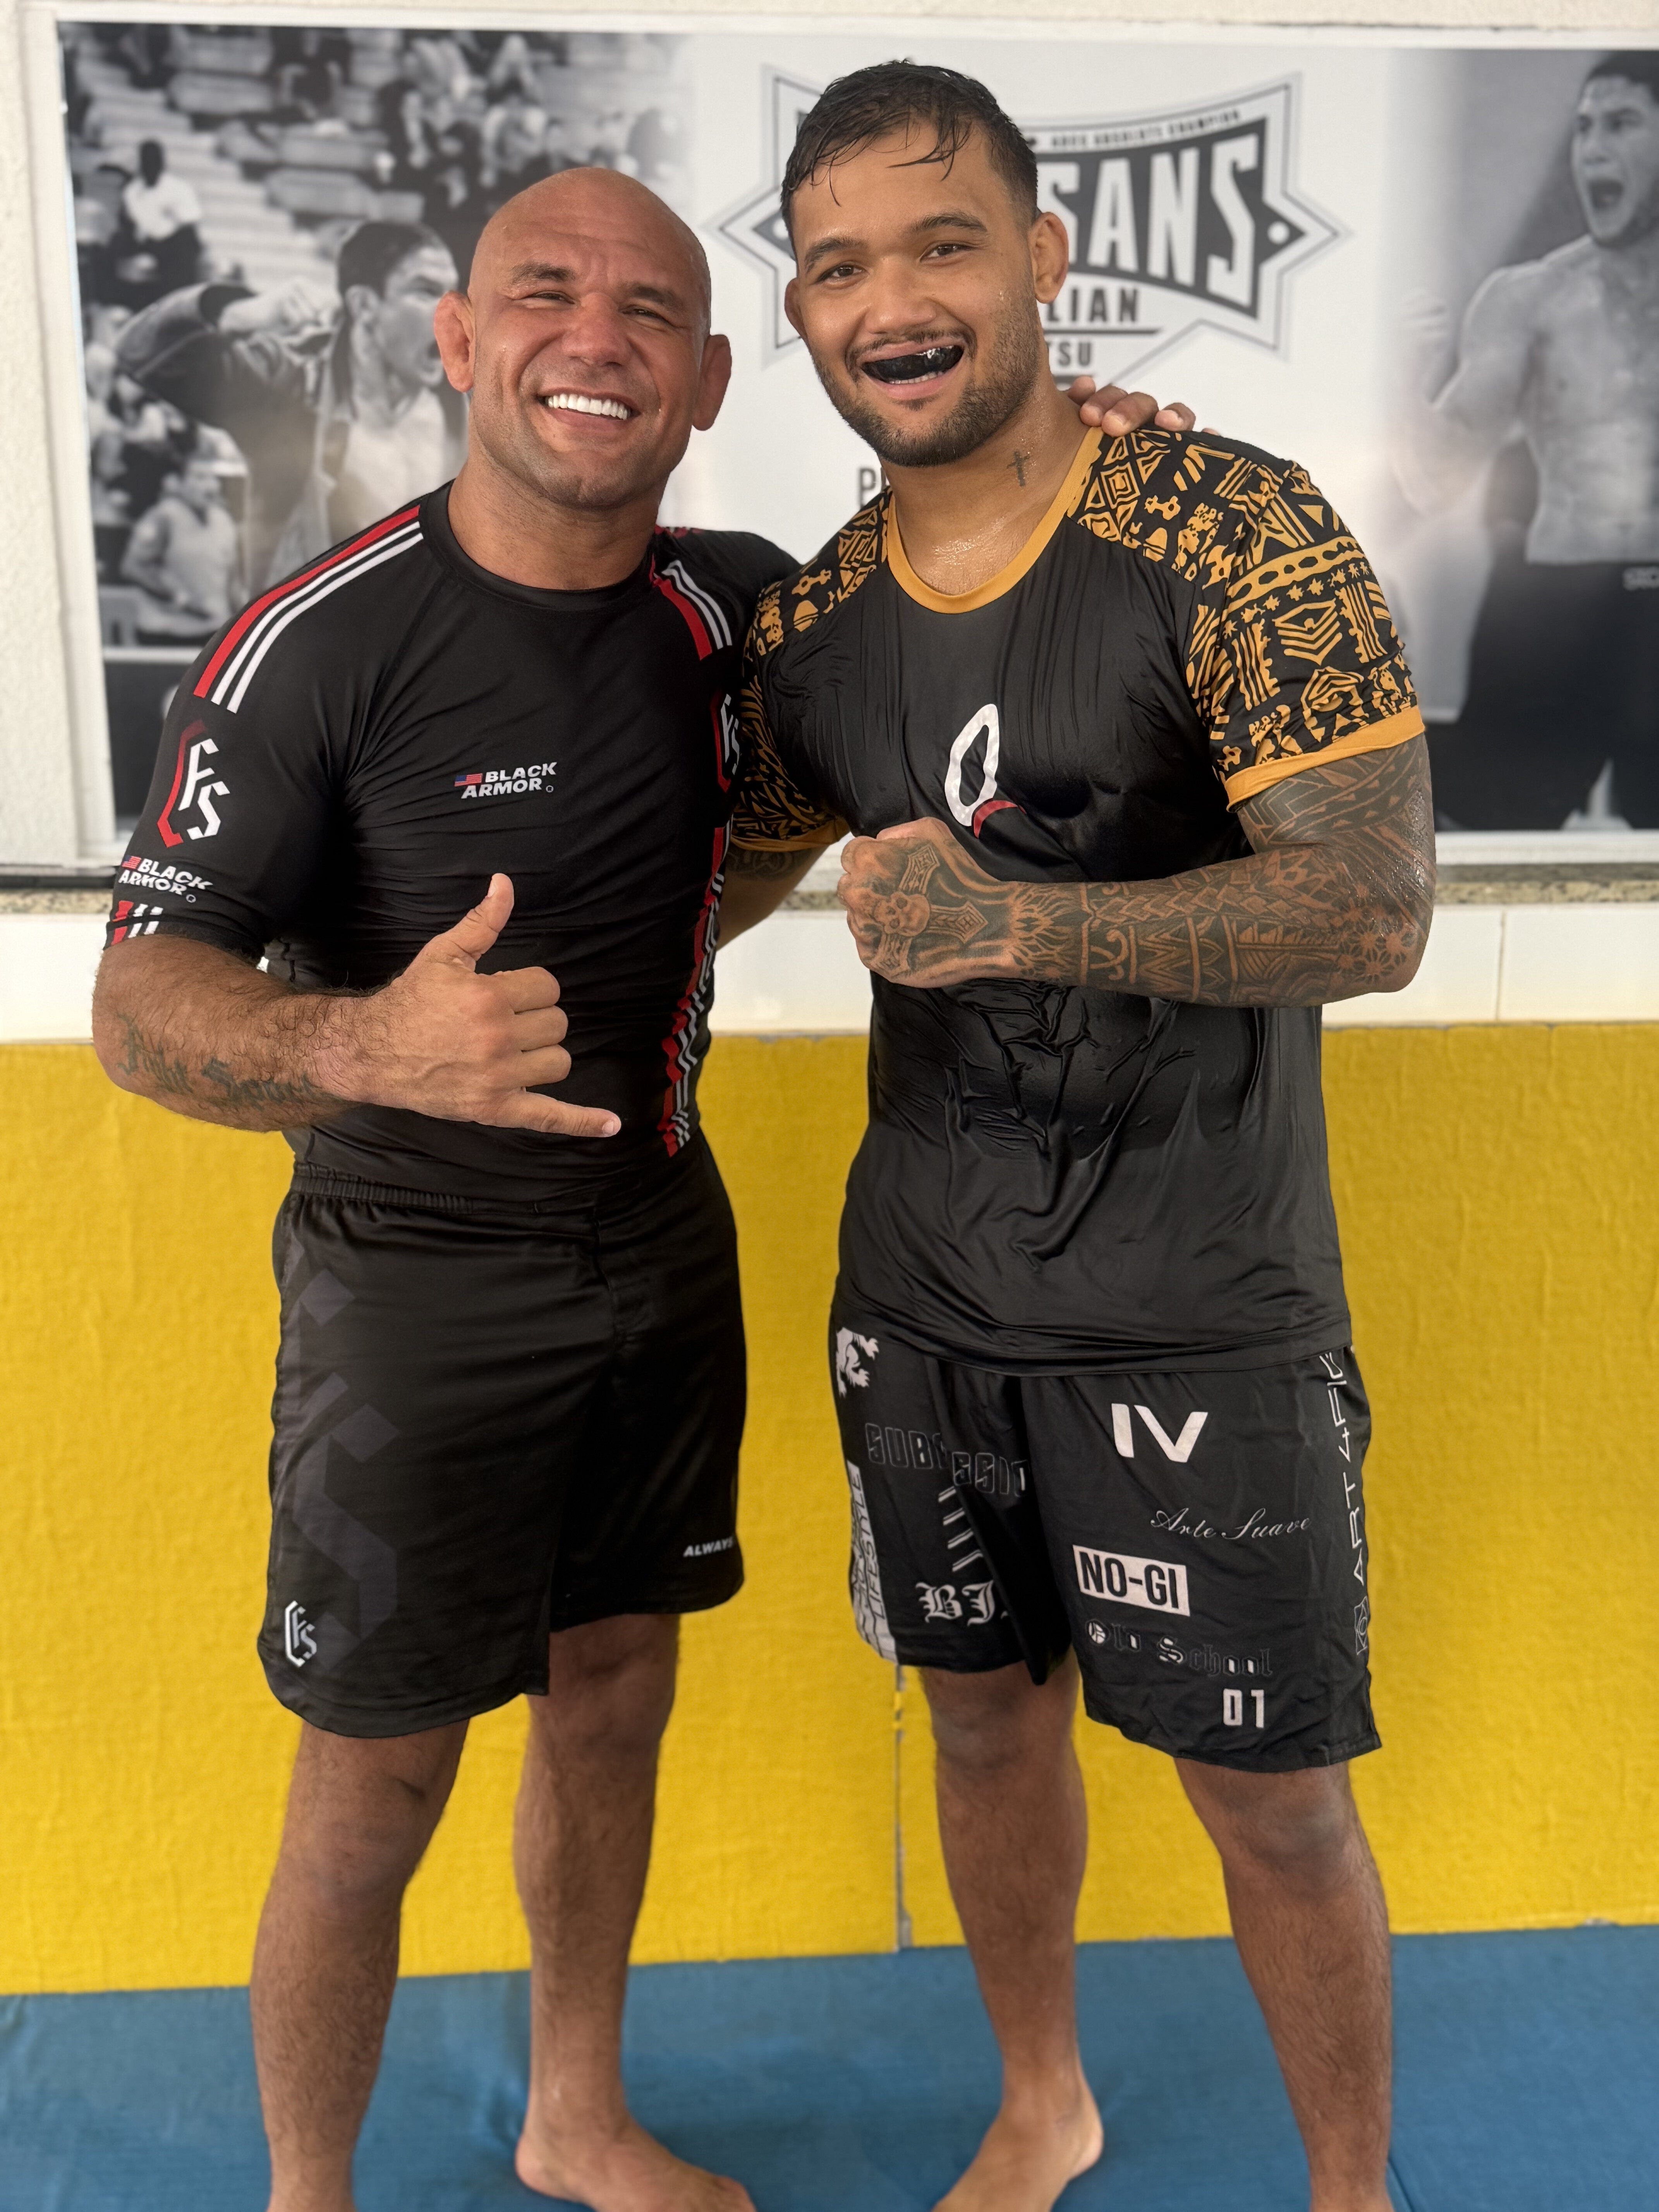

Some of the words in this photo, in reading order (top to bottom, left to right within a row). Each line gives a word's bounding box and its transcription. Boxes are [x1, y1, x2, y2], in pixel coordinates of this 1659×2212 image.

[1046, 342, 1092, 367] SU
[461, 778, 542, 799] ARMOR
[485, 762, 557, 783] BLACK
[118, 870, 187, 895] ARMOR
[137, 858, 213, 890] BLACK
[1111, 1403, 1208, 1463] IV
[1221, 1508, 1312, 1540] Suave
[852, 1473, 885, 1620] LIFESTYLE
[1079, 1551, 1179, 1609] NO-GI
[915, 1580, 1008, 1627] BJ
[1085, 1618, 1141, 1652] Old
[1156, 1635, 1273, 1677] School
[1223, 1688, 1264, 1728] 01
